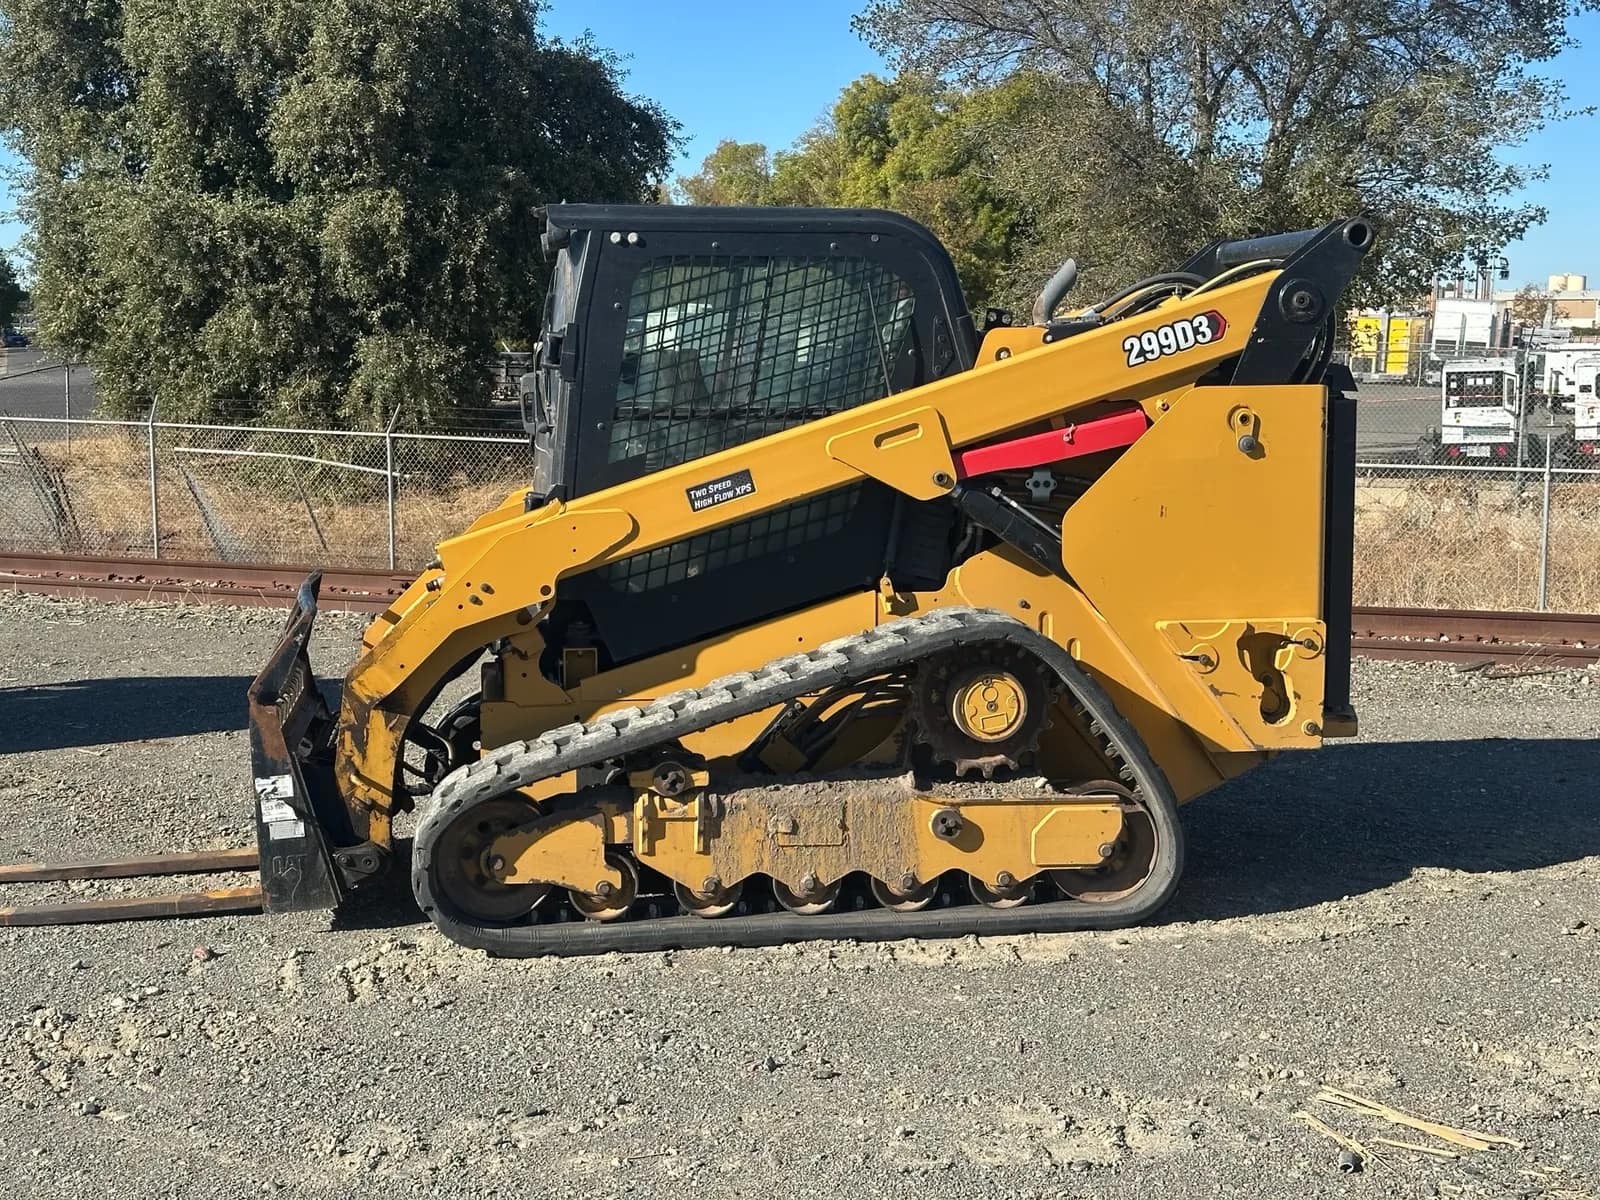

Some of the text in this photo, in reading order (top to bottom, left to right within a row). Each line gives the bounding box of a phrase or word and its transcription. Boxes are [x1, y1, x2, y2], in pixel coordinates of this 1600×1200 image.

[1123, 314, 1213, 367] 299D3
[690, 480, 732, 499] TWO SPEED
[694, 483, 752, 509] HIGH FLOW XPS
